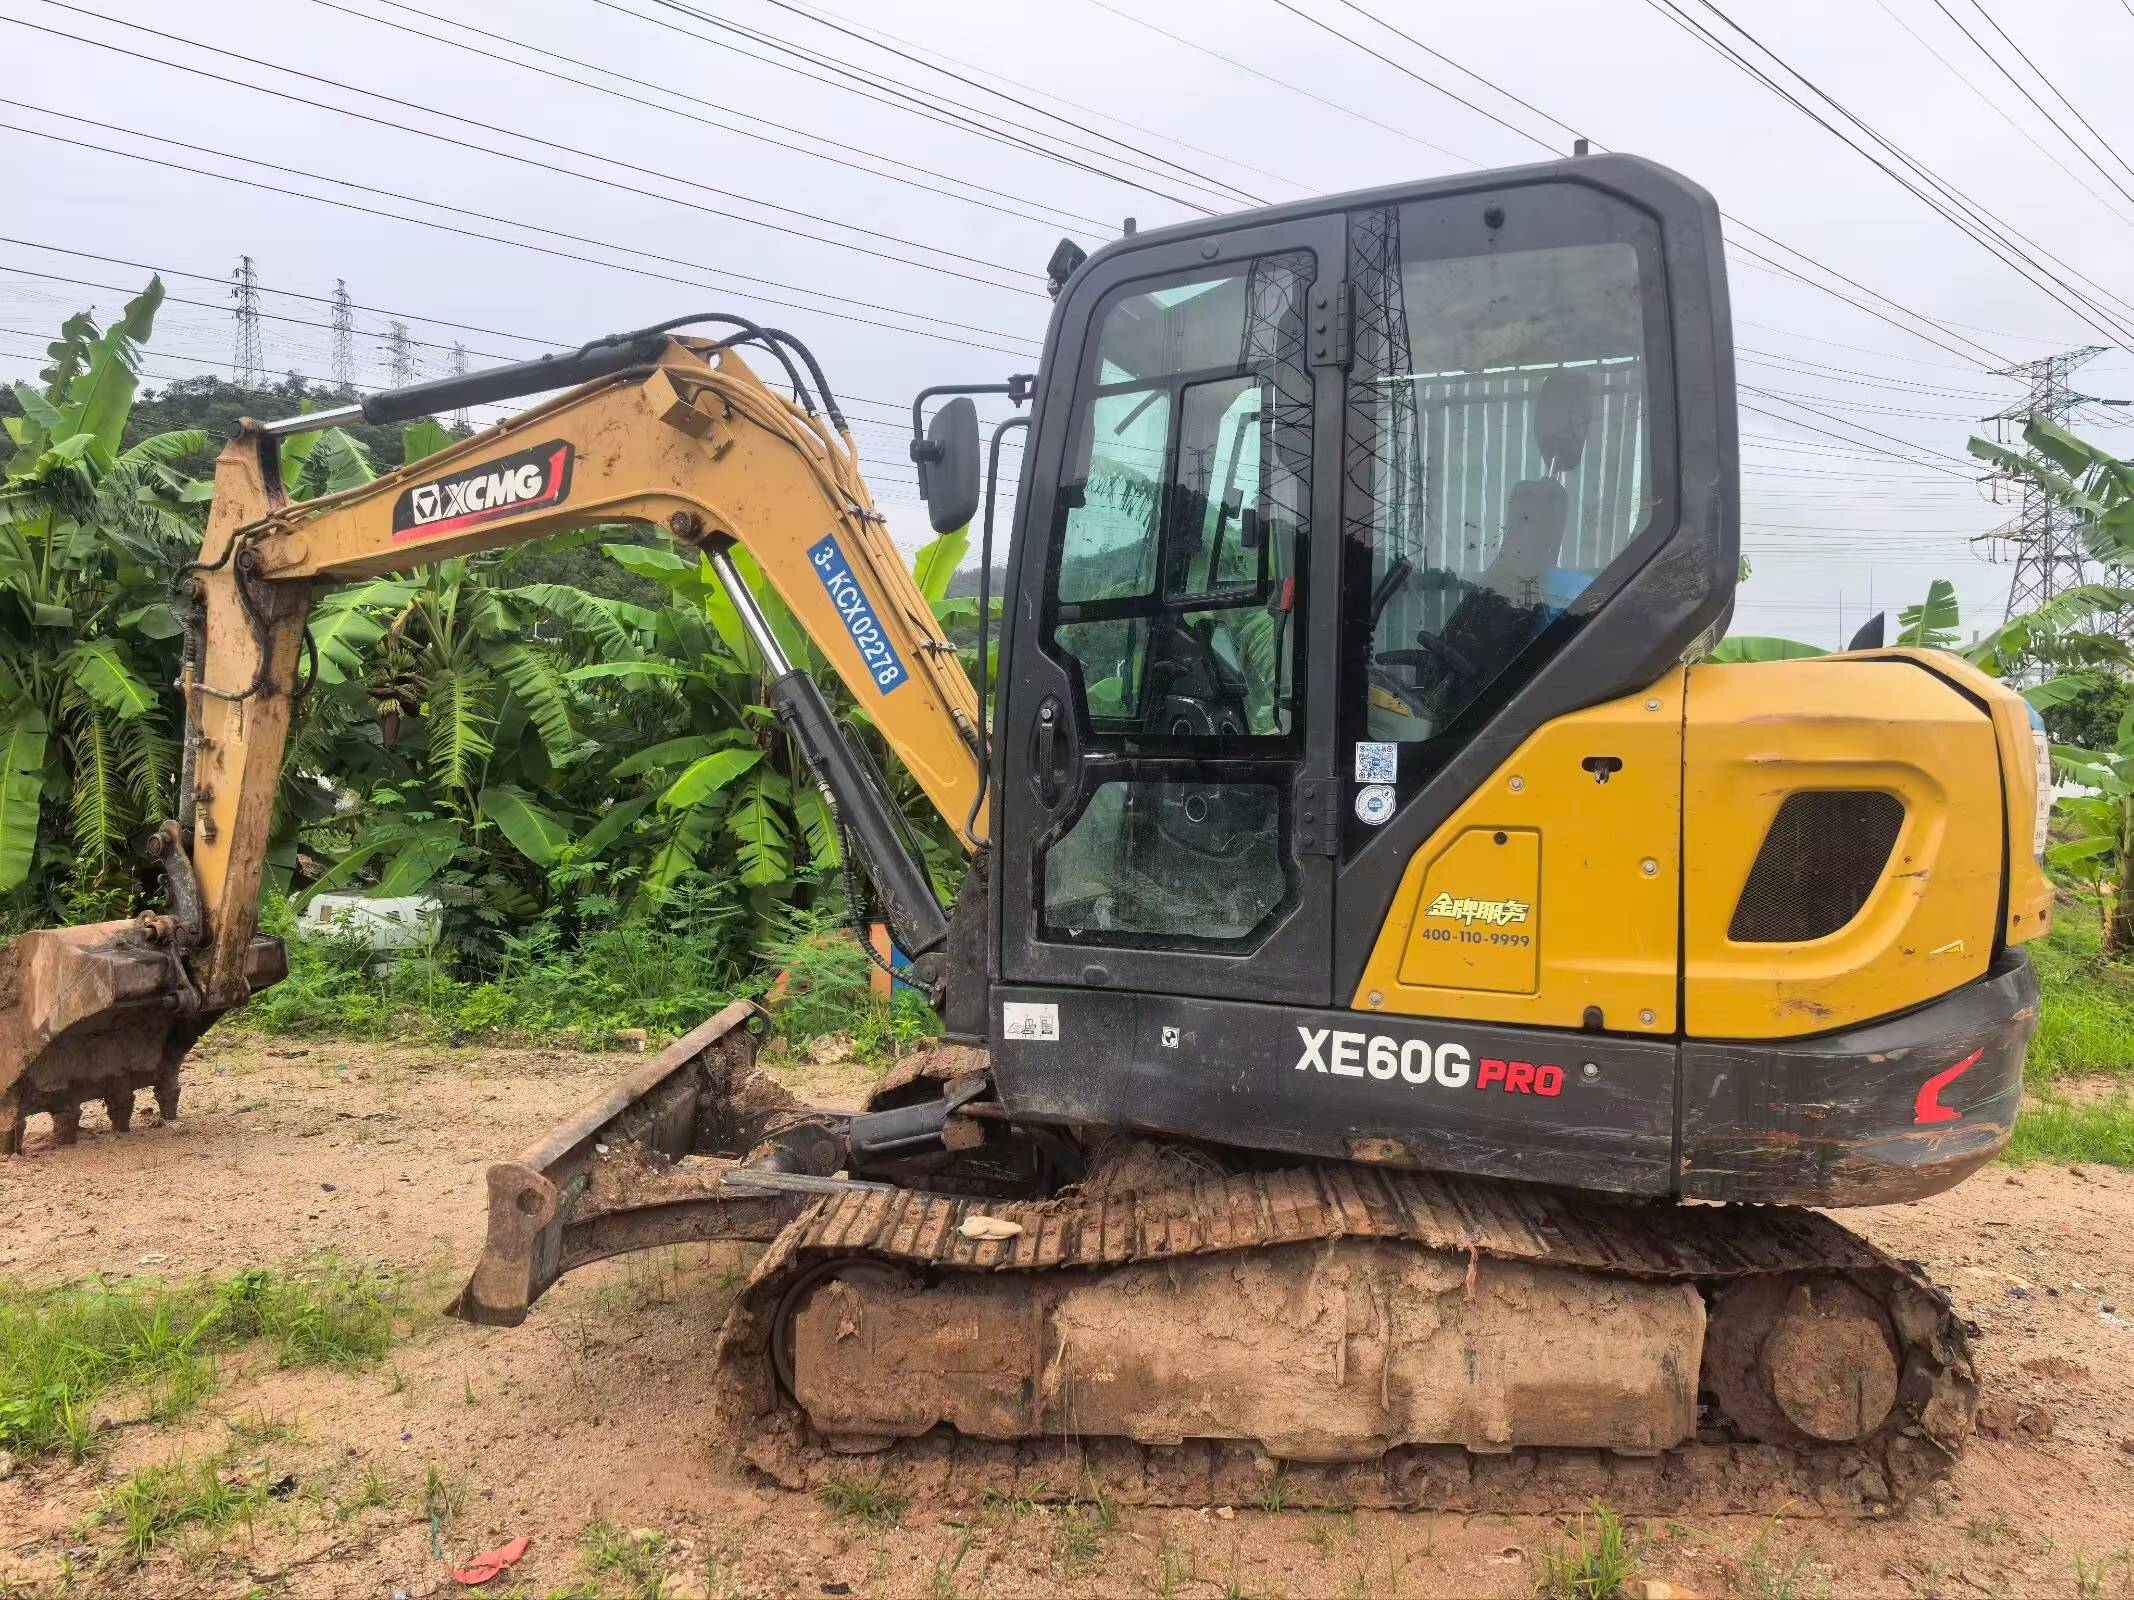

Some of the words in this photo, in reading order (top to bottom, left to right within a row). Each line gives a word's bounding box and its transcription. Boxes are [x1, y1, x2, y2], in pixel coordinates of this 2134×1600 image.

[442, 464, 542, 518] XCMG
[1424, 892, 1530, 927] 金牌服务
[1422, 928, 1530, 947] 400-110-9999
[1295, 1026, 1470, 1088] XE60G
[1476, 1057, 1564, 1097] PRO
